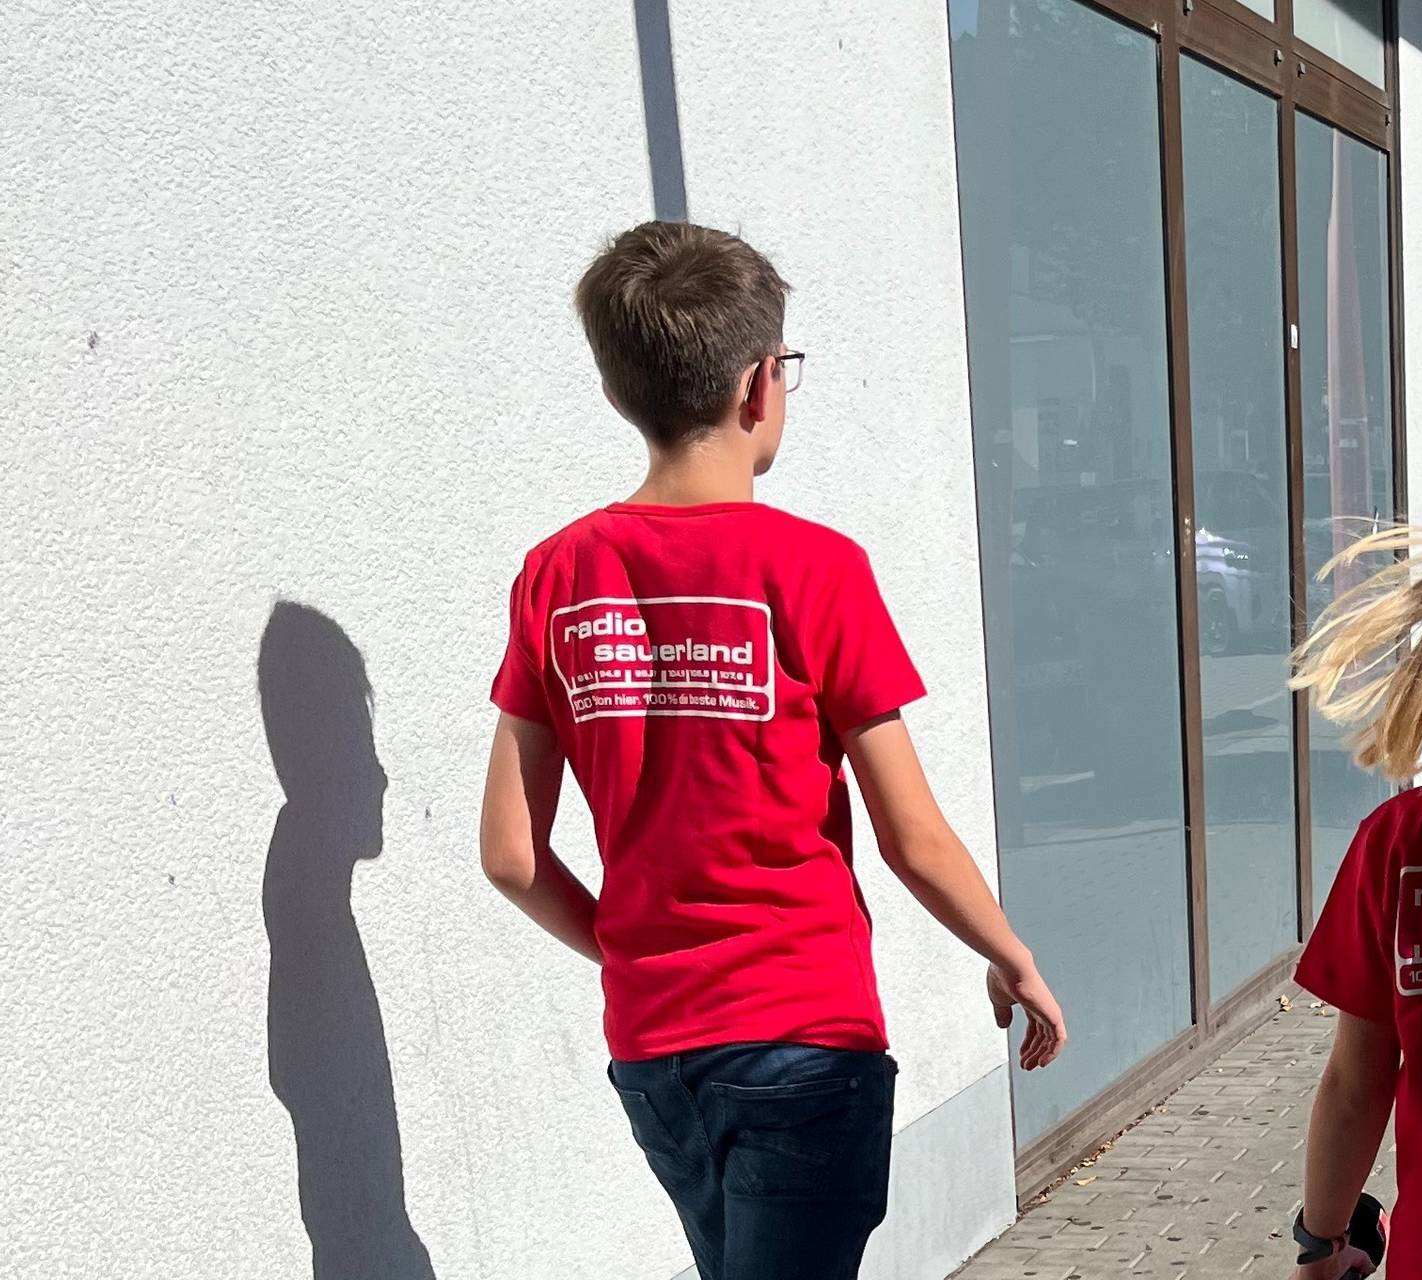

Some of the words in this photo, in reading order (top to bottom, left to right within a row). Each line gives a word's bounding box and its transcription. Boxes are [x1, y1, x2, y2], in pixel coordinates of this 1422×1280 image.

[564, 612, 647, 643] radio
[594, 638, 753, 665] sauerland
[643, 693, 678, 706] 100%
[719, 695, 761, 710] Musik.
